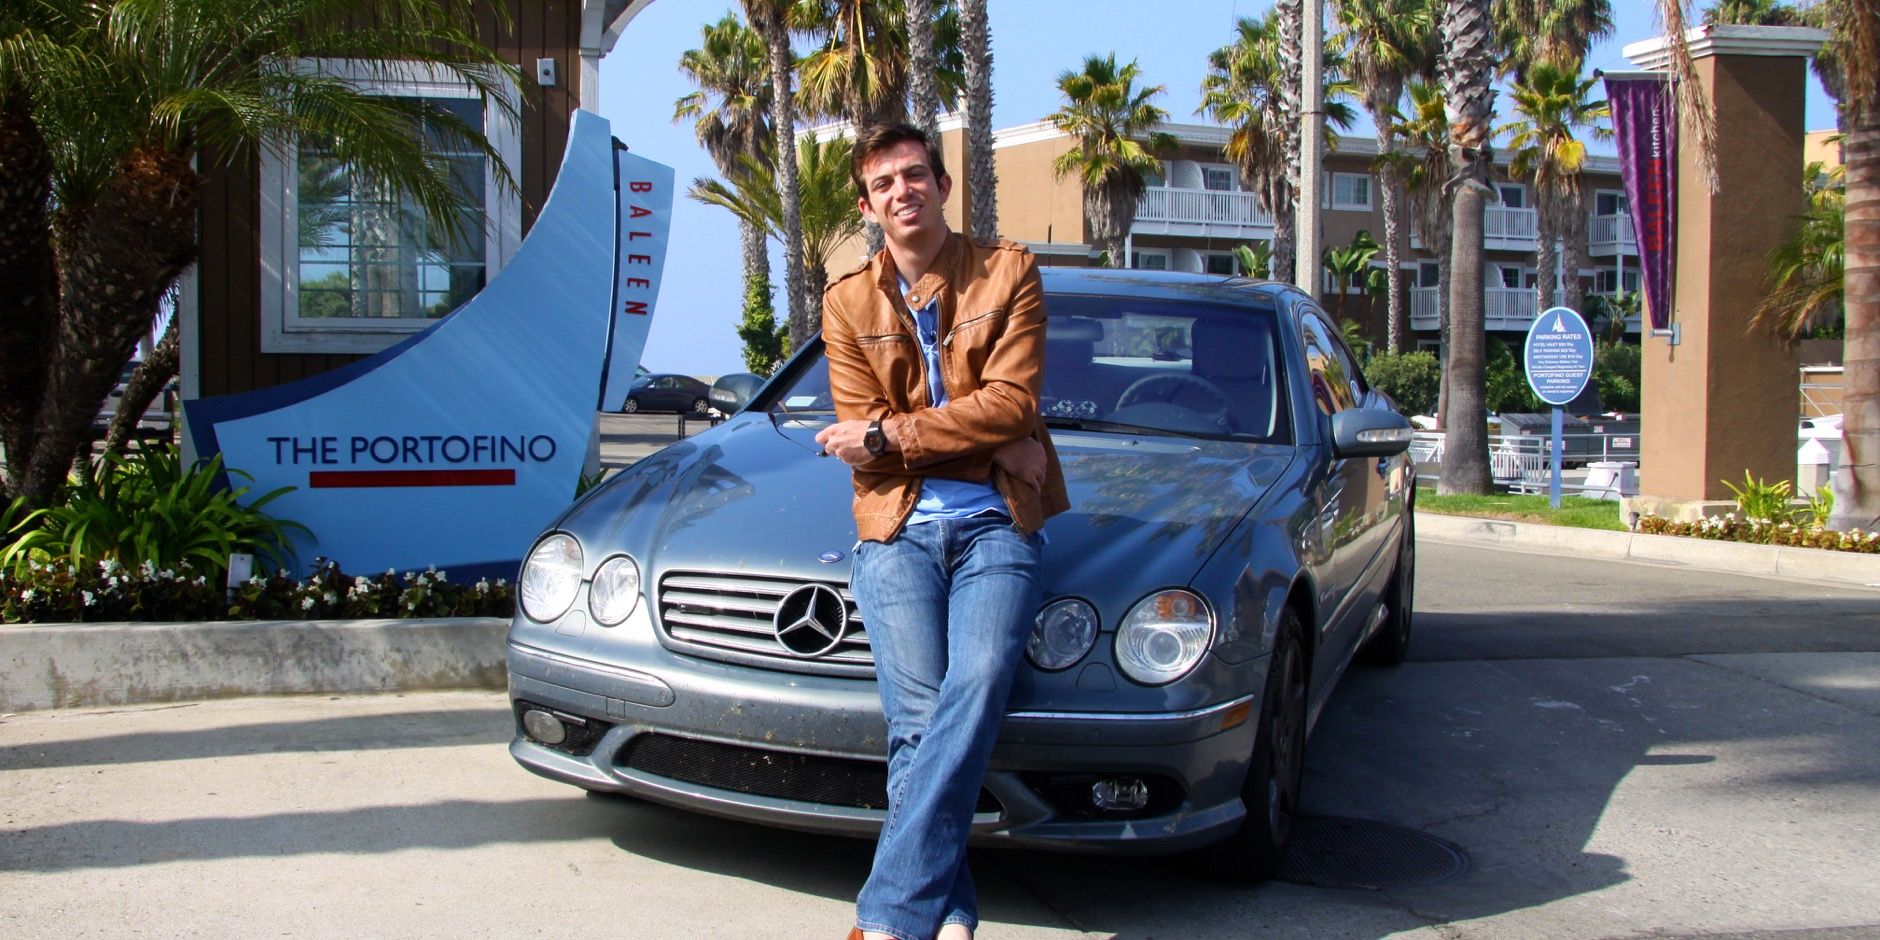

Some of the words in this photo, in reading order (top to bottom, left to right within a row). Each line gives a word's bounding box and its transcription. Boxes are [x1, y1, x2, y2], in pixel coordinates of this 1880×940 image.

[1650, 108, 1661, 158] kitchen
[624, 181, 653, 316] BALEEN
[267, 436, 338, 464] THE
[351, 434, 556, 464] PORTOFINO
